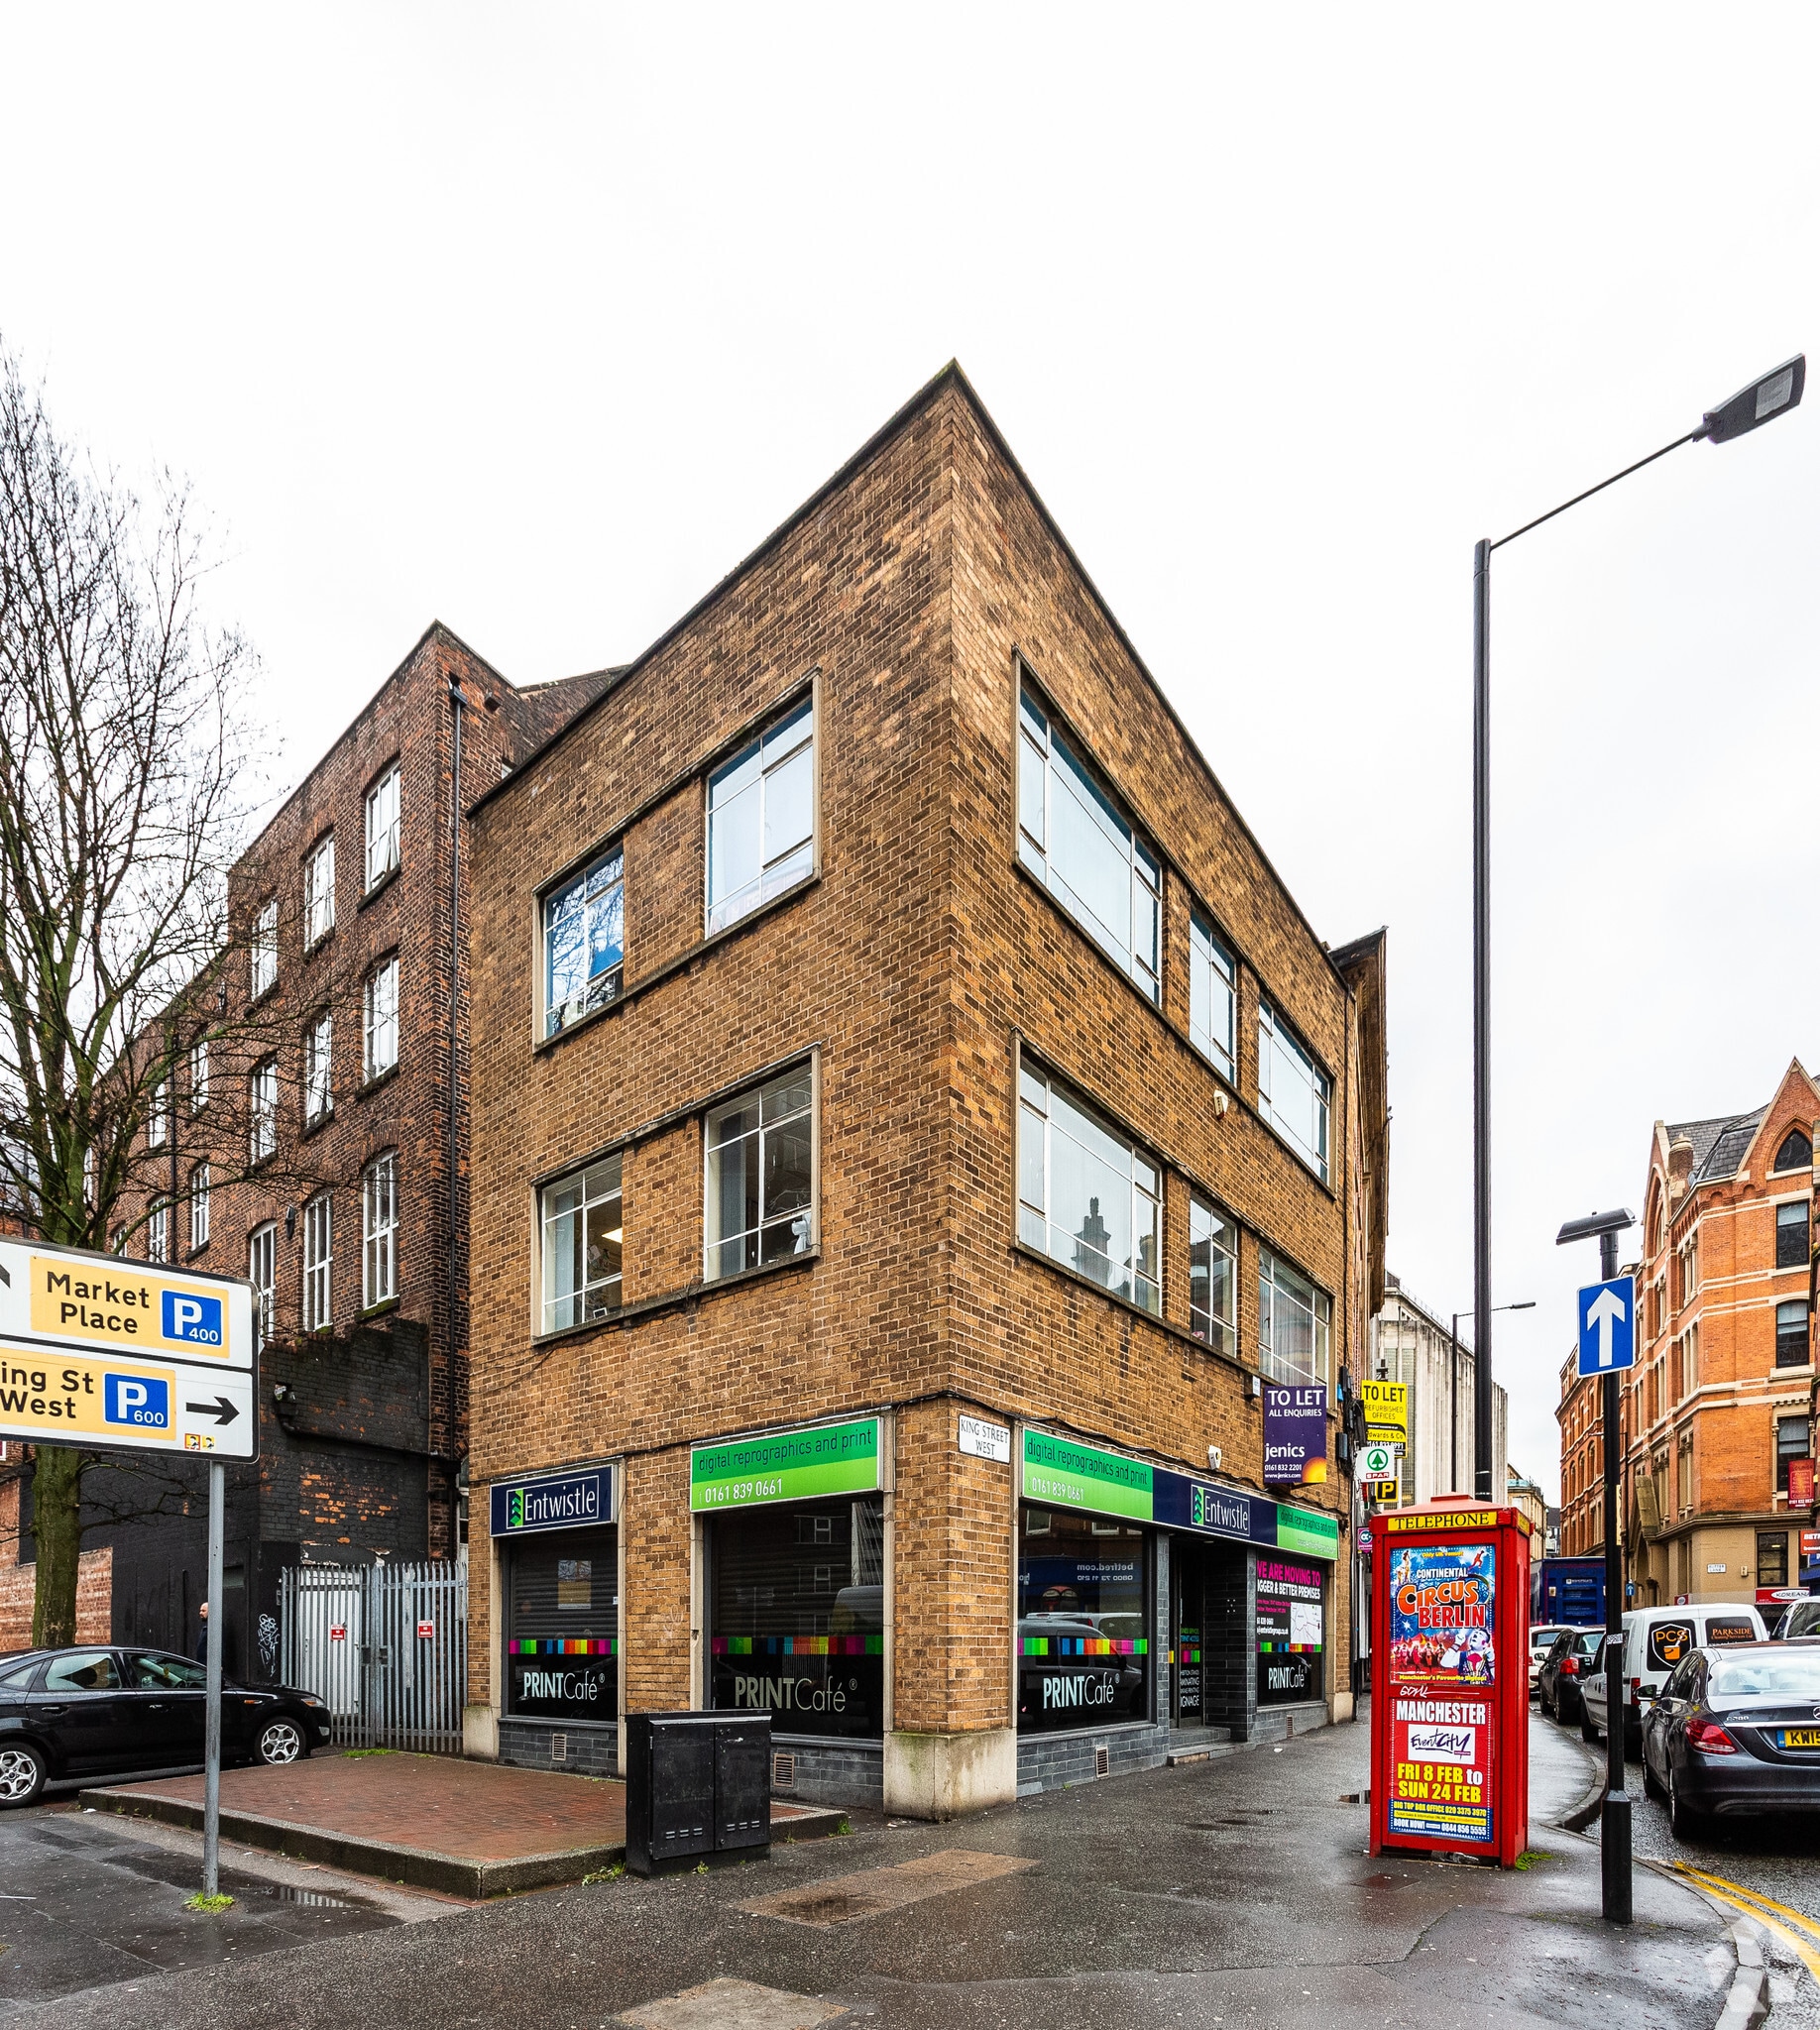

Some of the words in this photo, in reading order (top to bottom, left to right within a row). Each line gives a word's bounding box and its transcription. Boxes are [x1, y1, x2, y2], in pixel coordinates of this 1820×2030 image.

[47, 1271, 150, 1309] Market
[60, 1301, 138, 1334] Place
[173, 1297, 202, 1336] P
[188, 1327, 219, 1342] 400
[1, 1361, 47, 1393] ing
[60, 1369, 94, 1395] St
[0, 1390, 77, 1418] West
[117, 1381, 148, 1419] P
[134, 1410, 165, 1425] 600
[1268, 1390, 1291, 1406] TO
[1297, 1390, 1323, 1406] LET
[1363, 1386, 1379, 1401] TO
[1383, 1386, 1405, 1402] LET
[1269, 1409, 1283, 1417] ALL
[1284, 1409, 1322, 1417] ENQUIRIES
[1364, 1404, 1404, 1413] REFURBISHED
[960, 1418, 980, 1436] KING
[981, 1424, 1009, 1444] STREET
[699, 1450, 731, 1475] digital
[733, 1440, 812, 1469] reprographics
[815, 1433, 838, 1453] and
[842, 1428, 872, 1453] print
[975, 1438, 995, 1456] WEST
[1264, 1442, 1305, 1462] jenics
[1027, 1438, 1056, 1463] digital
[1057, 1450, 1114, 1477] reprographics
[1114, 1463, 1129, 1480] and
[1130, 1468, 1148, 1486] print
[1289, 1463, 1302, 1472] 2201
[705, 1485, 730, 1504] 0161
[733, 1481, 753, 1501] 839
[755, 1477, 783, 1497] 0661
[1032, 1476, 1051, 1495] 0161
[1052, 1481, 1067, 1498] 839
[1067, 1485, 1084, 1502] 0661
[1382, 1482, 1395, 1498] P
[524, 1483, 596, 1522] Entwistle
[1204, 1495, 1249, 1531] Entwistle
[1395, 1513, 1490, 1529] TELEPHONE
[1269, 1563, 1283, 1581] ARE
[1285, 1565, 1311, 1586] MOVING
[1311, 1570, 1321, 1587] TO
[1417, 1567, 1469, 1579] CONTINENTAL
[1257, 1578, 1274, 1593] IGGER
[1274, 1583, 1279, 1594] &
[1279, 1583, 1298, 1597] BETTER
[1299, 1586, 1320, 1600] PREMISES
[1396, 1580, 1479, 1616] CIRCUS
[1418, 1604, 1486, 1629] BERLIN
[1655, 1630, 1688, 1642] PCS
[1712, 1628, 1752, 1636] PARKSIDE
[523, 1670, 598, 1700] PRINTCafé
[1268, 1665, 1305, 1690] PRINTCafé
[735, 1675, 846, 1712] PRINTCafé
[1043, 1671, 1114, 1710] PRINTCafé
[1396, 1700, 1486, 1725] MANCHESTER
[1398, 1762, 1421, 1780] FRI
[1423, 1764, 1433, 1781] 8
[1436, 1765, 1463, 1783] FEB
[1466, 1768, 1483, 1785] to
[1398, 1780, 1428, 1799] SUN
[1431, 1783, 1451, 1801] 24
[1454, 1784, 1481, 1803] FEB
[1426, 1804, 1444, 1813] OFFICE
[1393, 1818, 1409, 1828] BOOK
[1410, 1820, 1424, 1829] NOW!
[1441, 1823, 1457, 1832] 0844
[1457, 1825, 1469, 1834] 856
[1470, 1826, 1487, 1836] 5555
